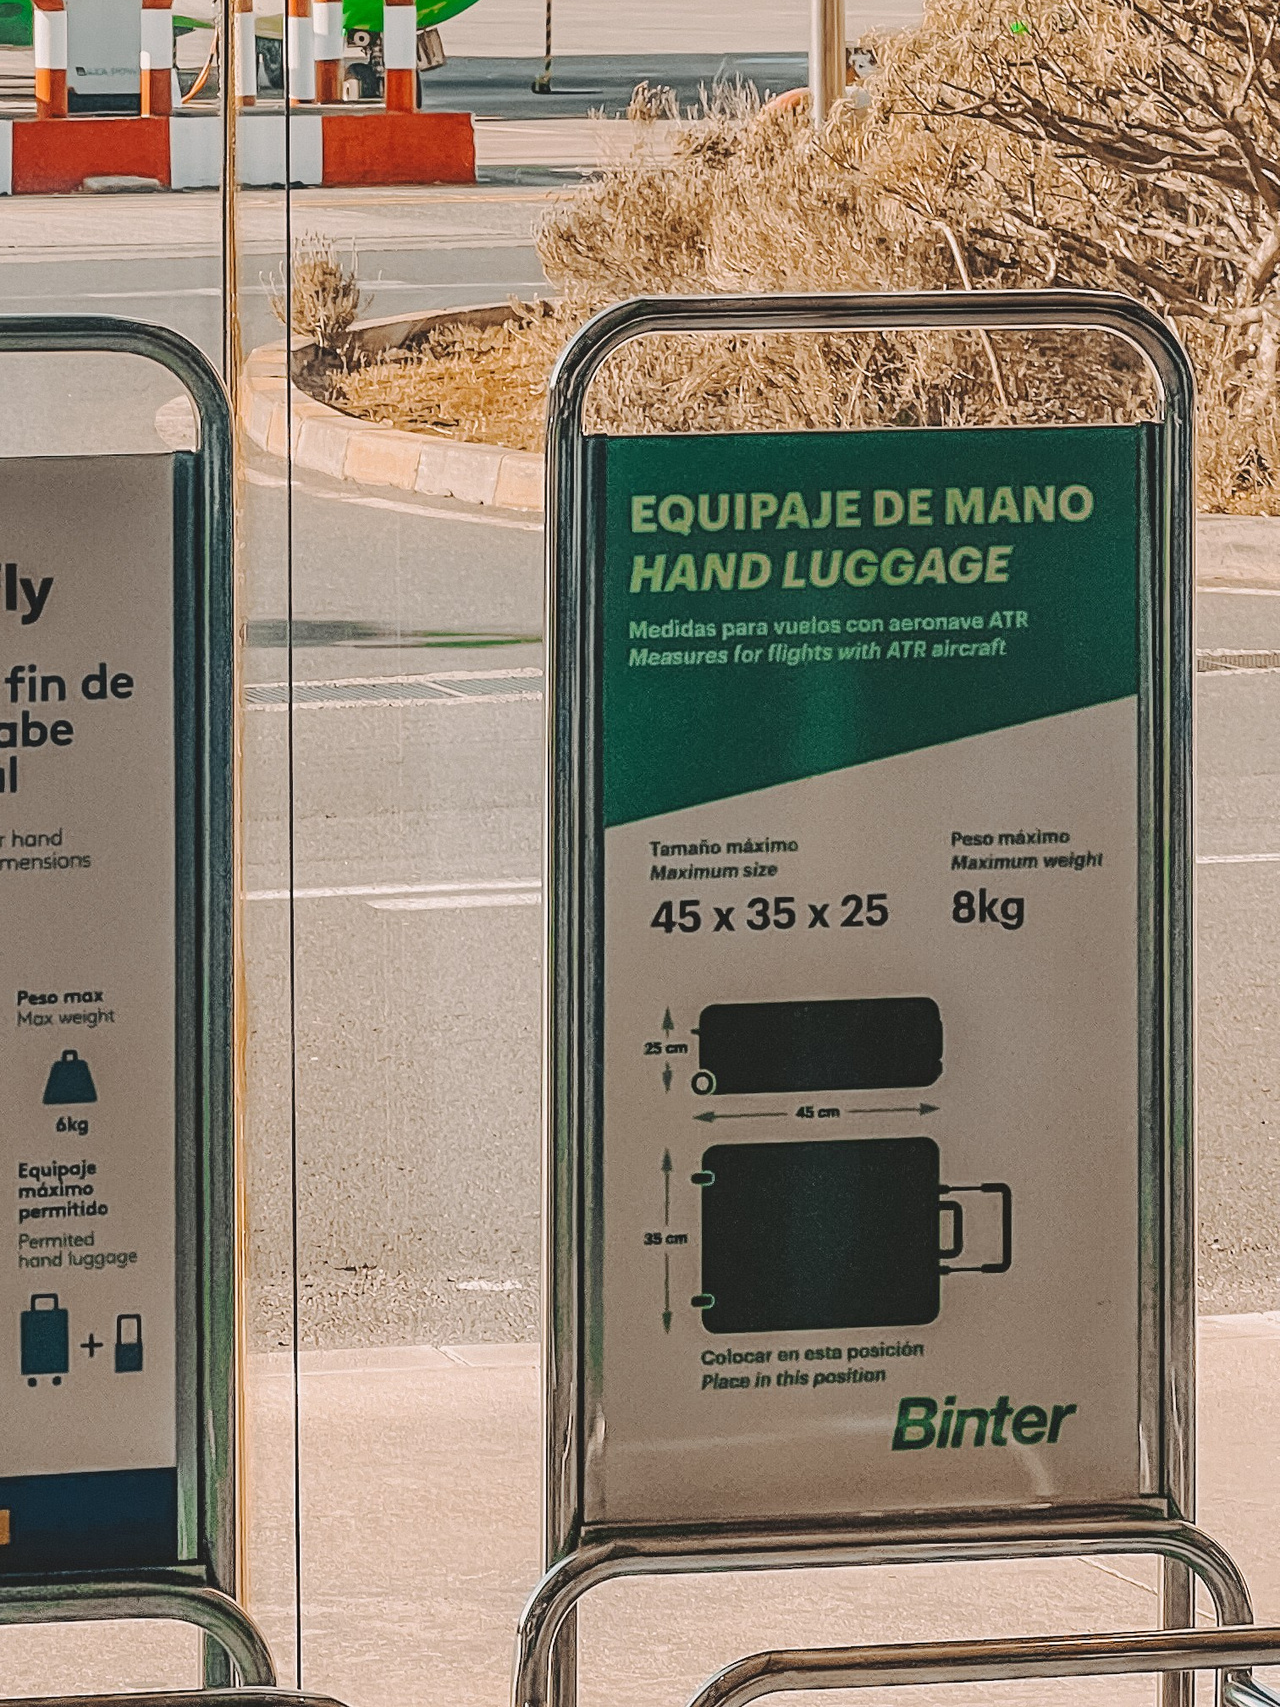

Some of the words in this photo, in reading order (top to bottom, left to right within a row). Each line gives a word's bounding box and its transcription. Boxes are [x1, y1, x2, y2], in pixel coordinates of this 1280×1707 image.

[631, 490, 861, 535] EQUIPAJE
[874, 488, 933, 527] DE
[945, 485, 1094, 524] MANO
[629, 552, 772, 593] HAND
[782, 545, 1014, 589] LUGGAGE
[629, 618, 717, 640] Medidas
[722, 619, 767, 641] para
[773, 616, 841, 635] vuelos
[846, 616, 883, 632] con
[889, 614, 984, 631] aeronave
[989, 610, 1029, 629] ATR
[629, 646, 728, 667] Measures
[733, 645, 763, 663] for
[768, 642, 833, 666] flights
[838, 641, 881, 660] with
[886, 640, 926, 658] ATR
[931, 638, 1006, 657] aircraft
[5, 665, 66, 704] fin
[81, 663, 134, 699] de
[12, 829, 63, 847] hand
[649, 839, 721, 856] Tamaño
[727, 836, 798, 854] máximo
[951, 830, 999, 847] Peso
[1004, 829, 1070, 845] máximo
[651, 862, 739, 881] Maximum
[743, 861, 778, 878] size
[951, 853, 1038, 871] Maximum
[1043, 851, 1103, 871] weight
[651, 900, 701, 933] 45
[713, 907, 735, 931] x
[747, 896, 796, 930] 35
[808, 903, 829, 928] x
[841, 893, 889, 927] 25
[952, 889, 1025, 930] 8kg
[18, 990, 58, 1005] Peso
[64, 991, 103, 1003] max
[18, 1012, 52, 1026] Max
[59, 1008, 114, 1028] weight
[644, 1042, 662, 1055] 25
[666, 1043, 688, 1054] cm
[795, 1107, 814, 1119] 45
[818, 1108, 840, 1118] cm
[56, 1116, 88, 1135] 6kg
[19, 1160, 96, 1182] Equipaje
[19, 1182, 94, 1198] máximo
[19, 1201, 108, 1224] permitido
[644, 1232, 662, 1245] 35
[666, 1233, 688, 1245] cm
[19, 1251, 62, 1268] hand
[68, 1252, 137, 1270] luggage
[701, 1348, 772, 1366] Colocar
[777, 1348, 799, 1362] en
[804, 1346, 842, 1361] esta
[847, 1341, 924, 1362] posición
[701, 1372, 749, 1390] Place
[755, 1371, 771, 1387] in
[776, 1369, 808, 1387] this
[813, 1367, 885, 1387] position
[891, 1396, 1076, 1451] Binter
